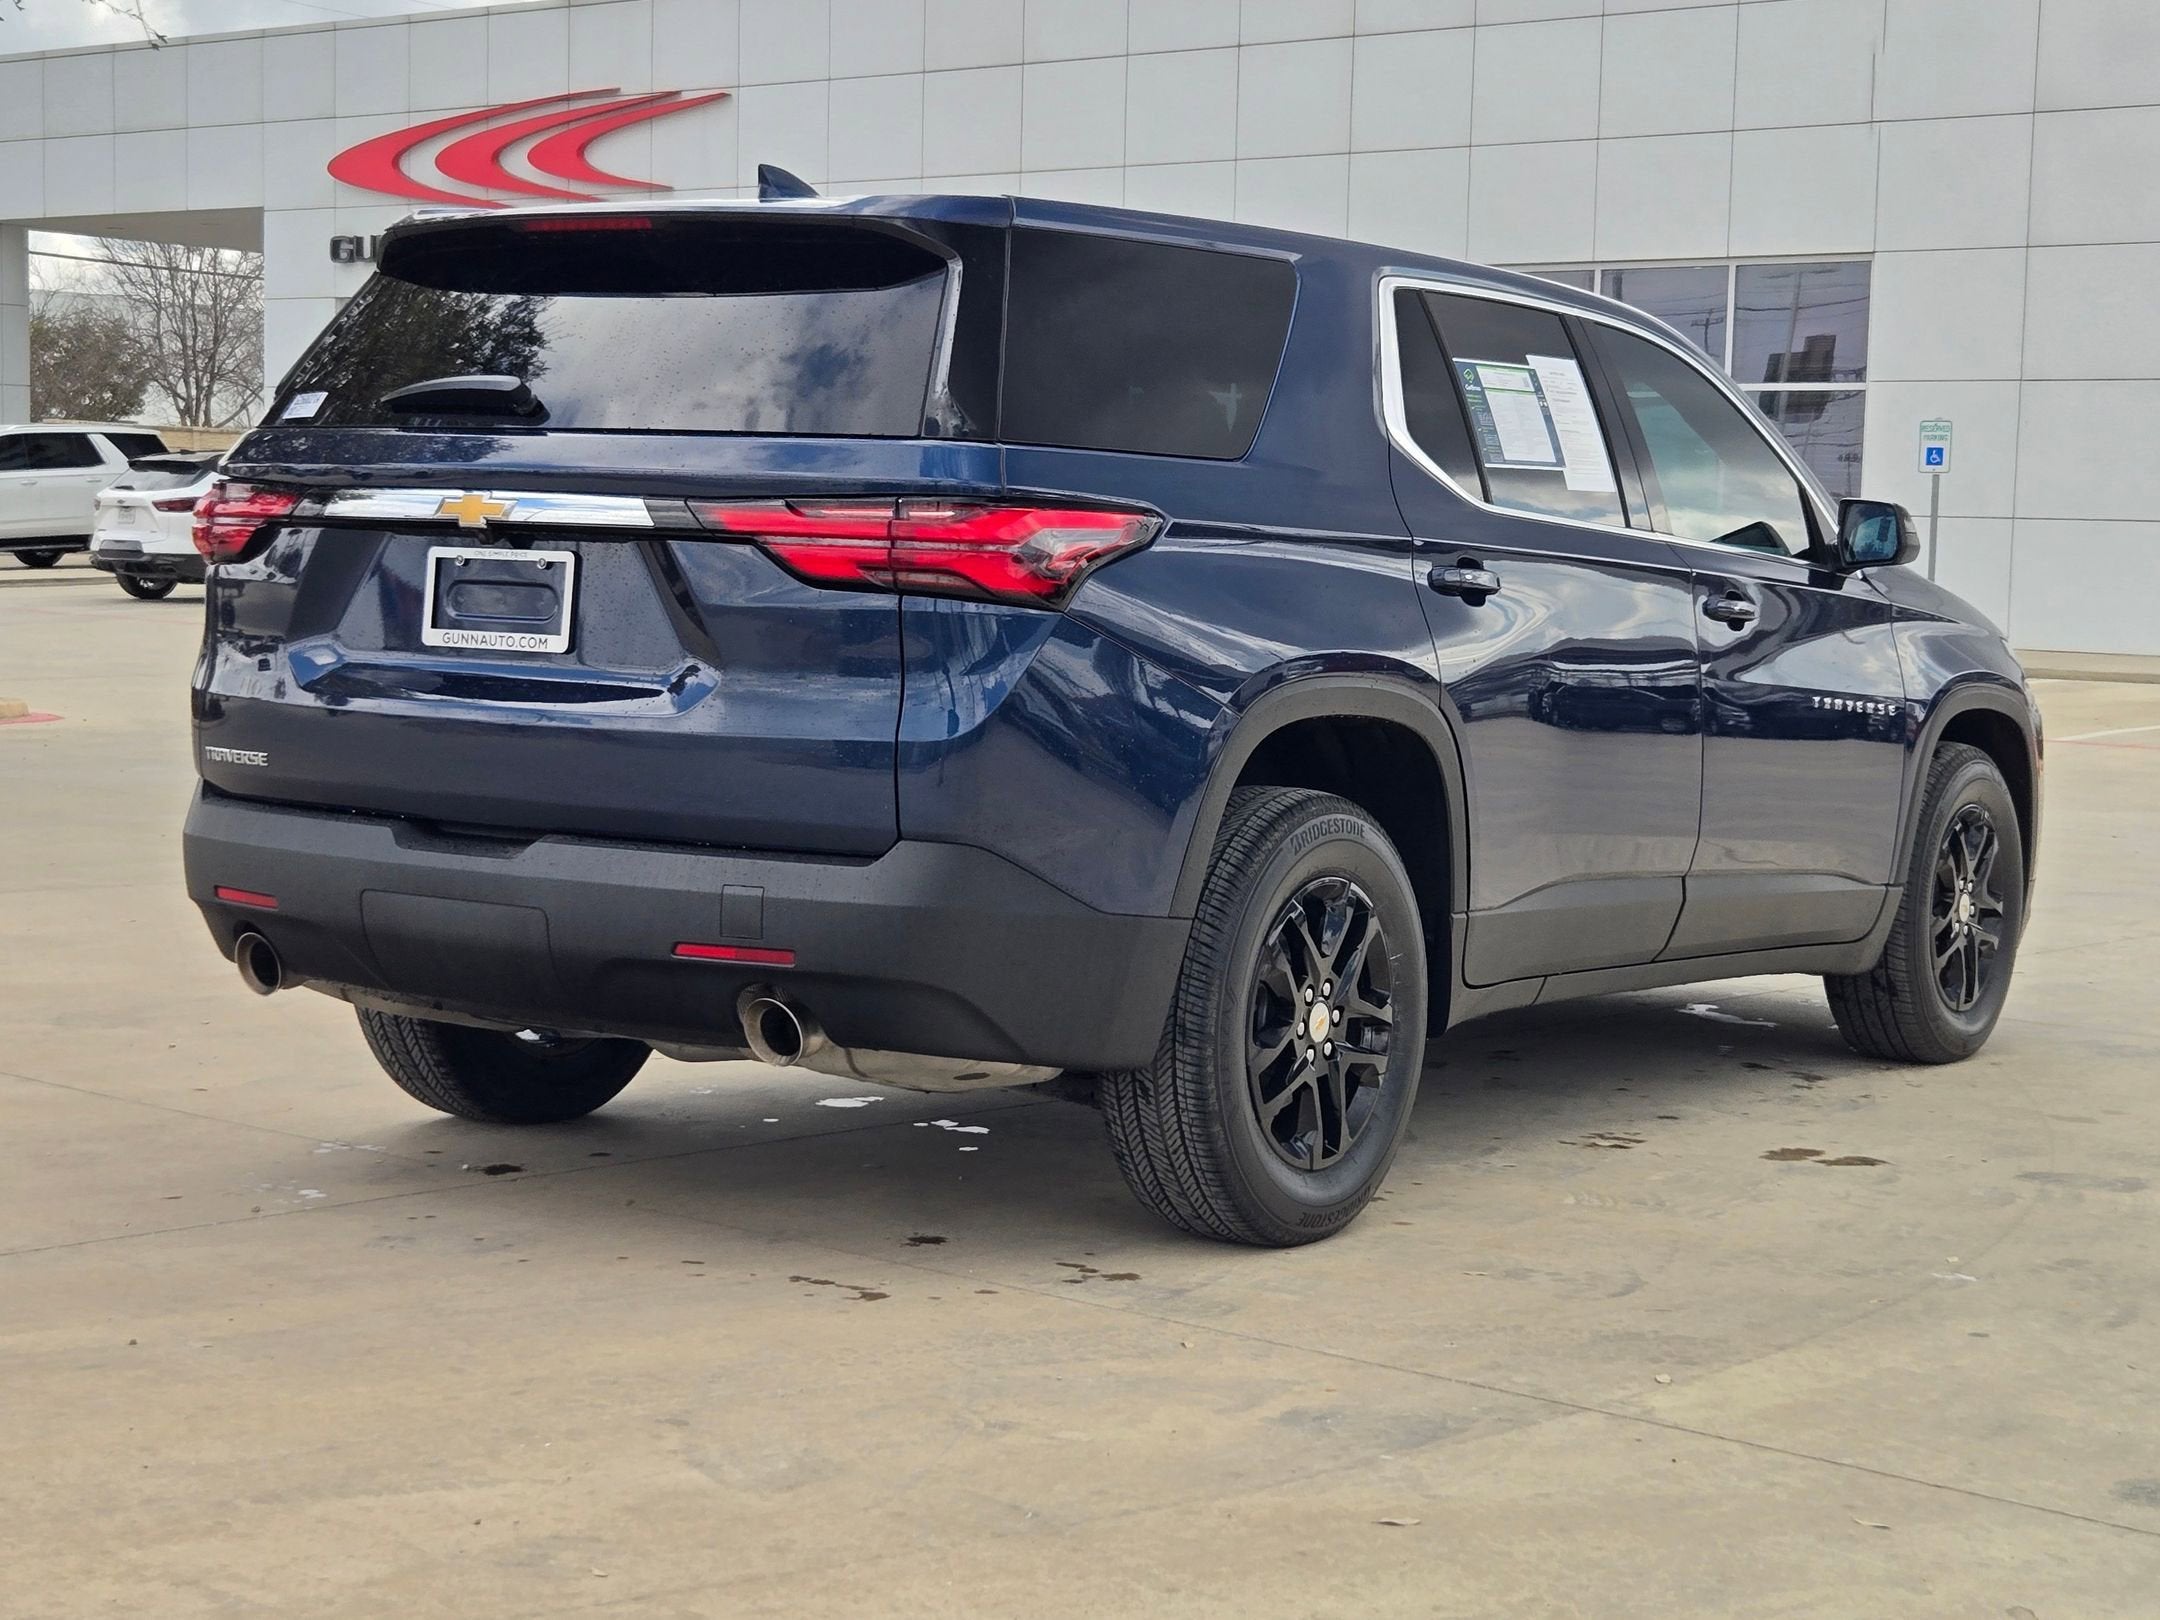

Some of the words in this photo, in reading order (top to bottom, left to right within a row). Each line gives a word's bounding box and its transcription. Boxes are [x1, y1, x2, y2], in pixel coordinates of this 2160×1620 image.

[442, 632, 549, 649] GUNNAUTO.COM
[1812, 696, 1897, 716] TRAVERSE
[205, 745, 269, 767] TRAVERSE
[1289, 817, 1366, 856] BRIDGESTONE
